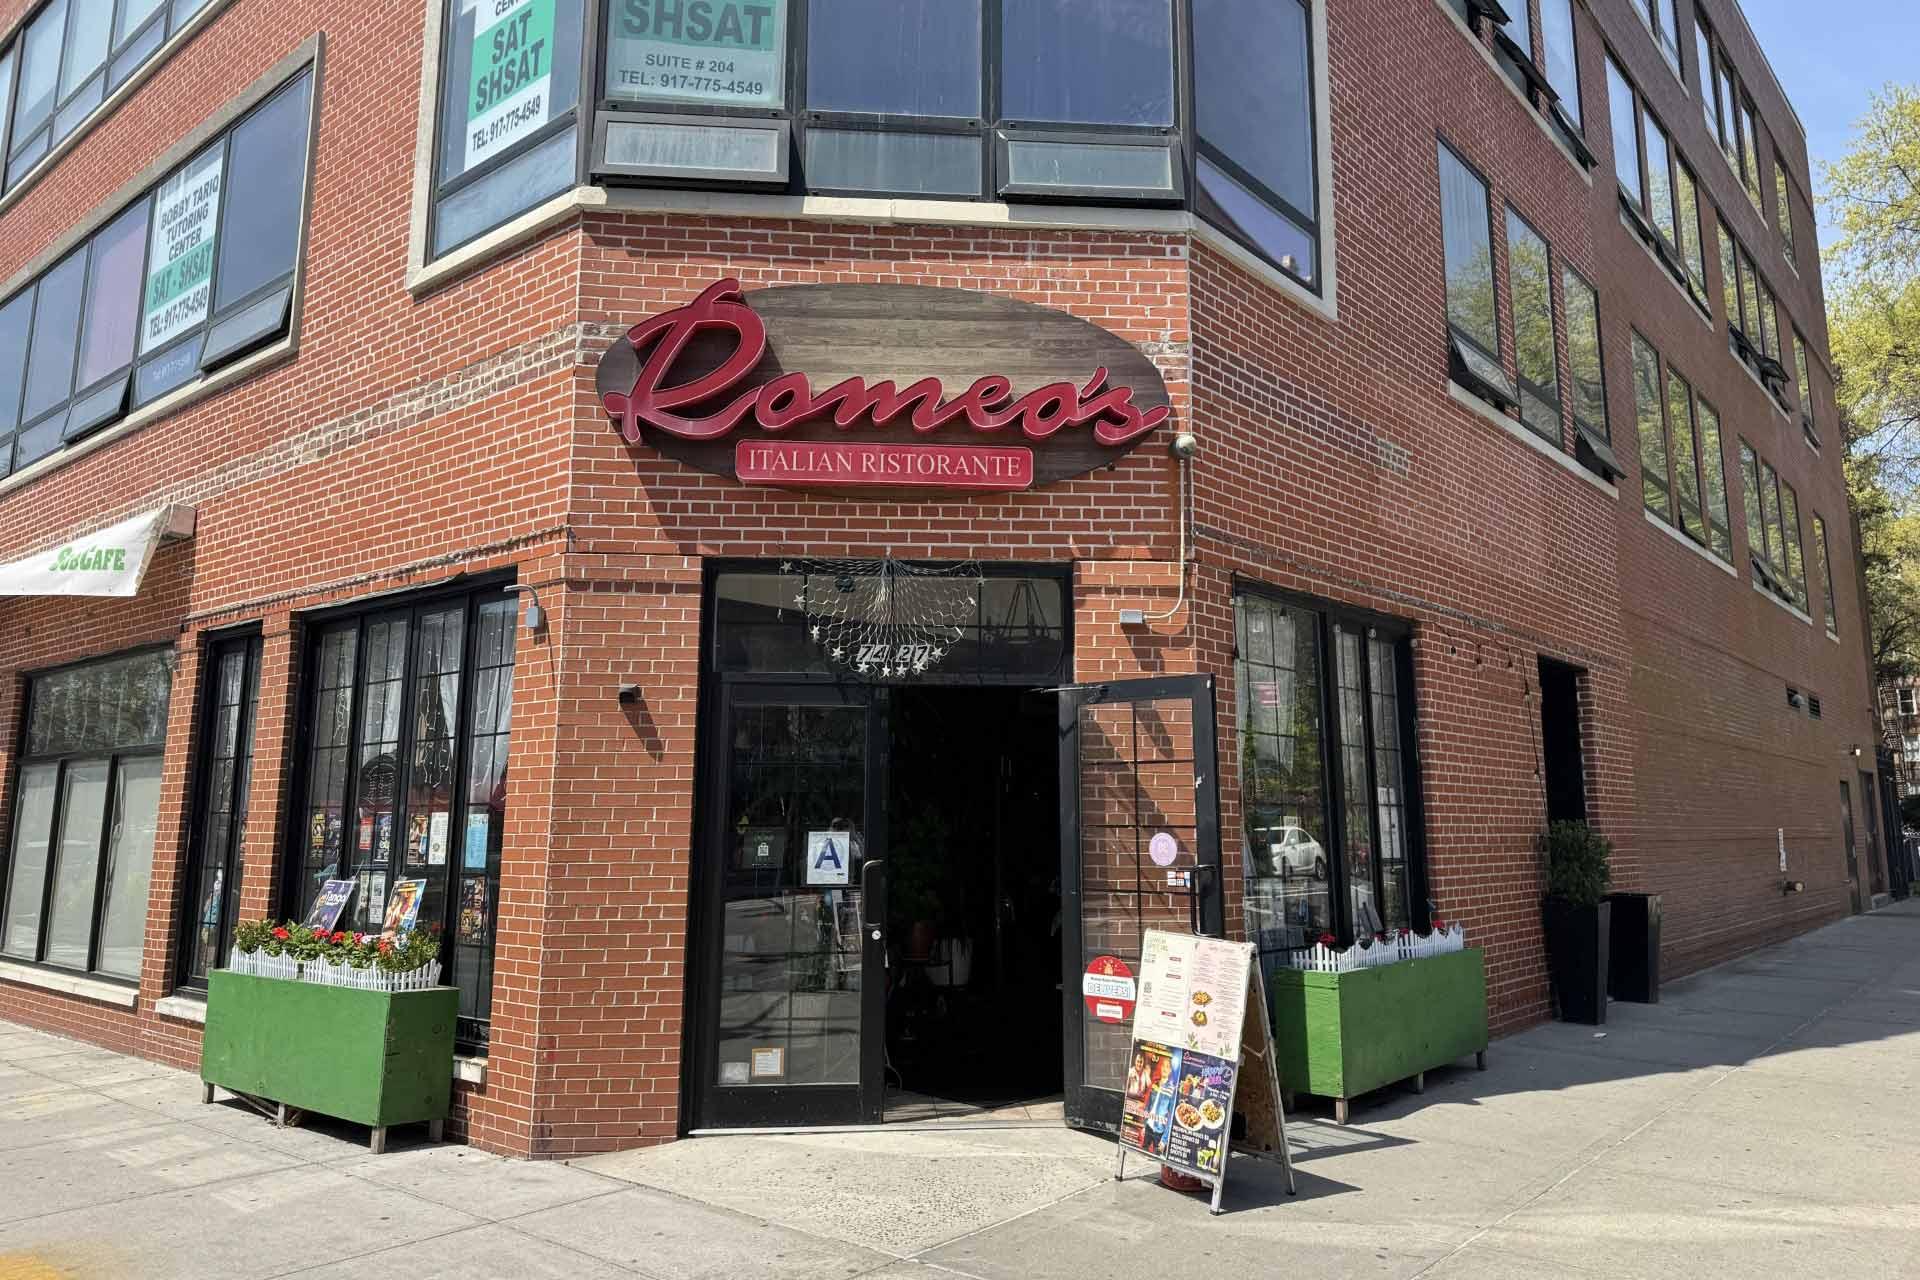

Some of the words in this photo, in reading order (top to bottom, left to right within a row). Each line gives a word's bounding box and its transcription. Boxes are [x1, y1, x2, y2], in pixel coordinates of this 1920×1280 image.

[492, 9, 532, 64] SAT
[623, 0, 771, 45] SHSAT
[475, 38, 544, 112] SHSAT
[619, 70, 655, 86] TEL:
[660, 73, 763, 95] 917-775-4549
[645, 54, 691, 70] SUITE
[695, 60, 705, 71] #
[709, 60, 735, 73] 204
[472, 130, 488, 152] TEL:
[490, 95, 541, 141] 917-775-4549
[160, 197, 190, 231] BOBBY
[192, 174, 219, 208] TARIQ
[166, 202, 209, 245] TUTORING
[168, 227, 202, 262] CENTER
[153, 270, 172, 306] SAT
[179, 246, 212, 290] SHSAT
[603, 278, 1170, 446] Romeo's
[749, 448, 853, 475] ITALIAN
[861, 451, 1021, 478] RISTORANTE
[858, 645, 889, 662] 74
[897, 645, 929, 662] 27
[814, 837, 842, 869] A
